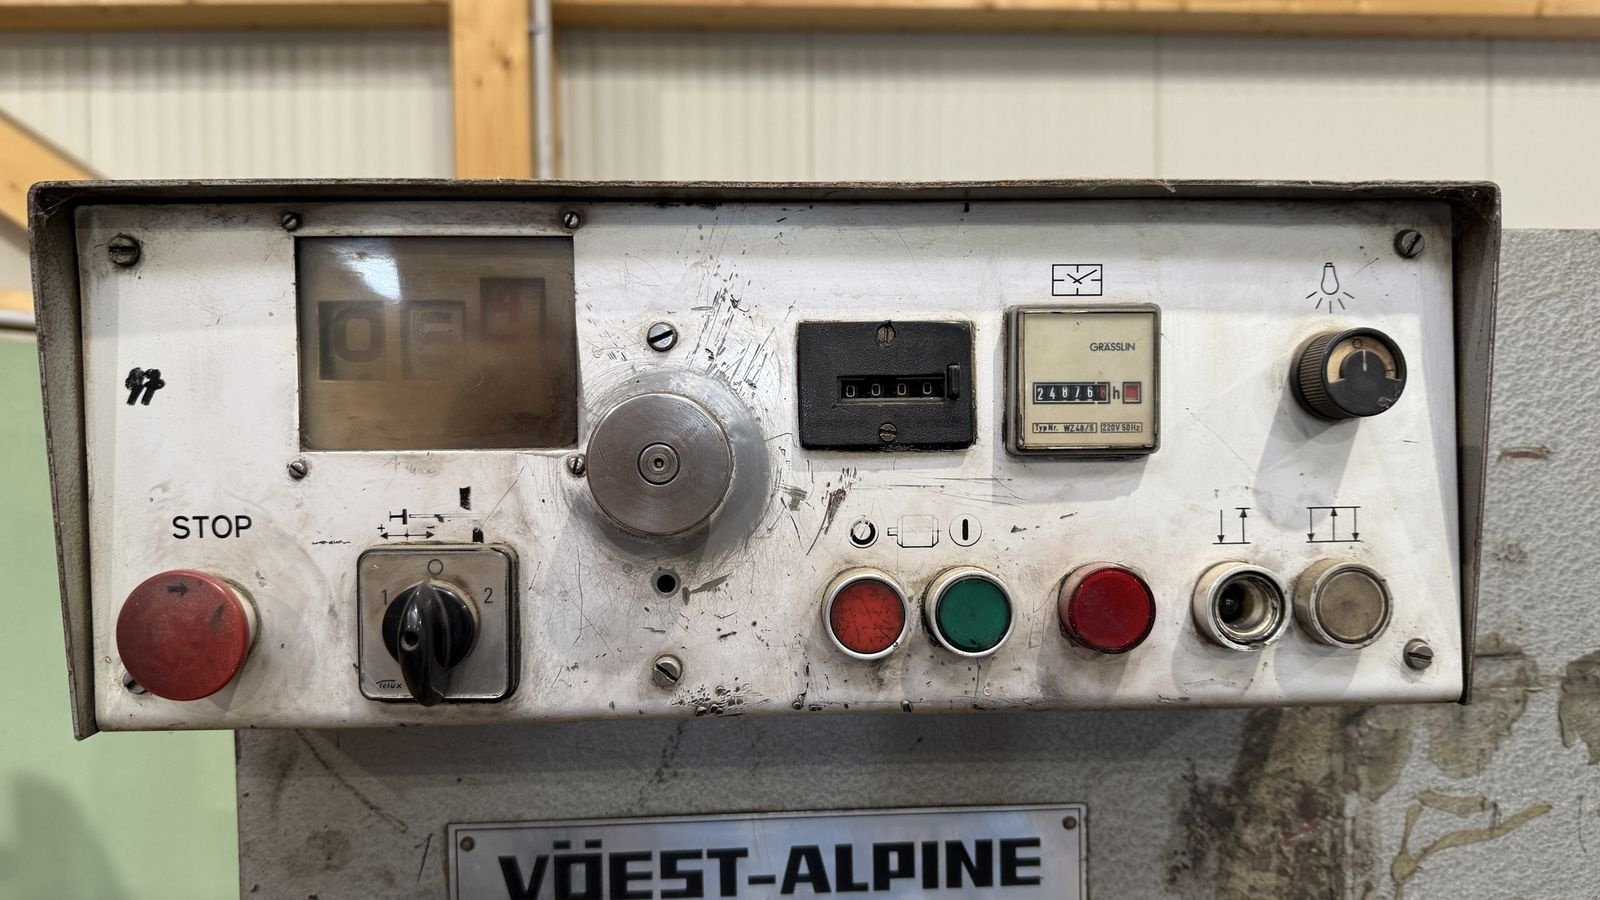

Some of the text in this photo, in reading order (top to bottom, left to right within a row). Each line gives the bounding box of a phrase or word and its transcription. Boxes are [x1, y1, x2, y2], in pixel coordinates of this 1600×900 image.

[1090, 341, 1136, 352] GRÄSSLIN
[172, 515, 252, 540] STOP
[484, 587, 494, 604] 2
[498, 837, 1042, 900] VÖEST-ALPINE
